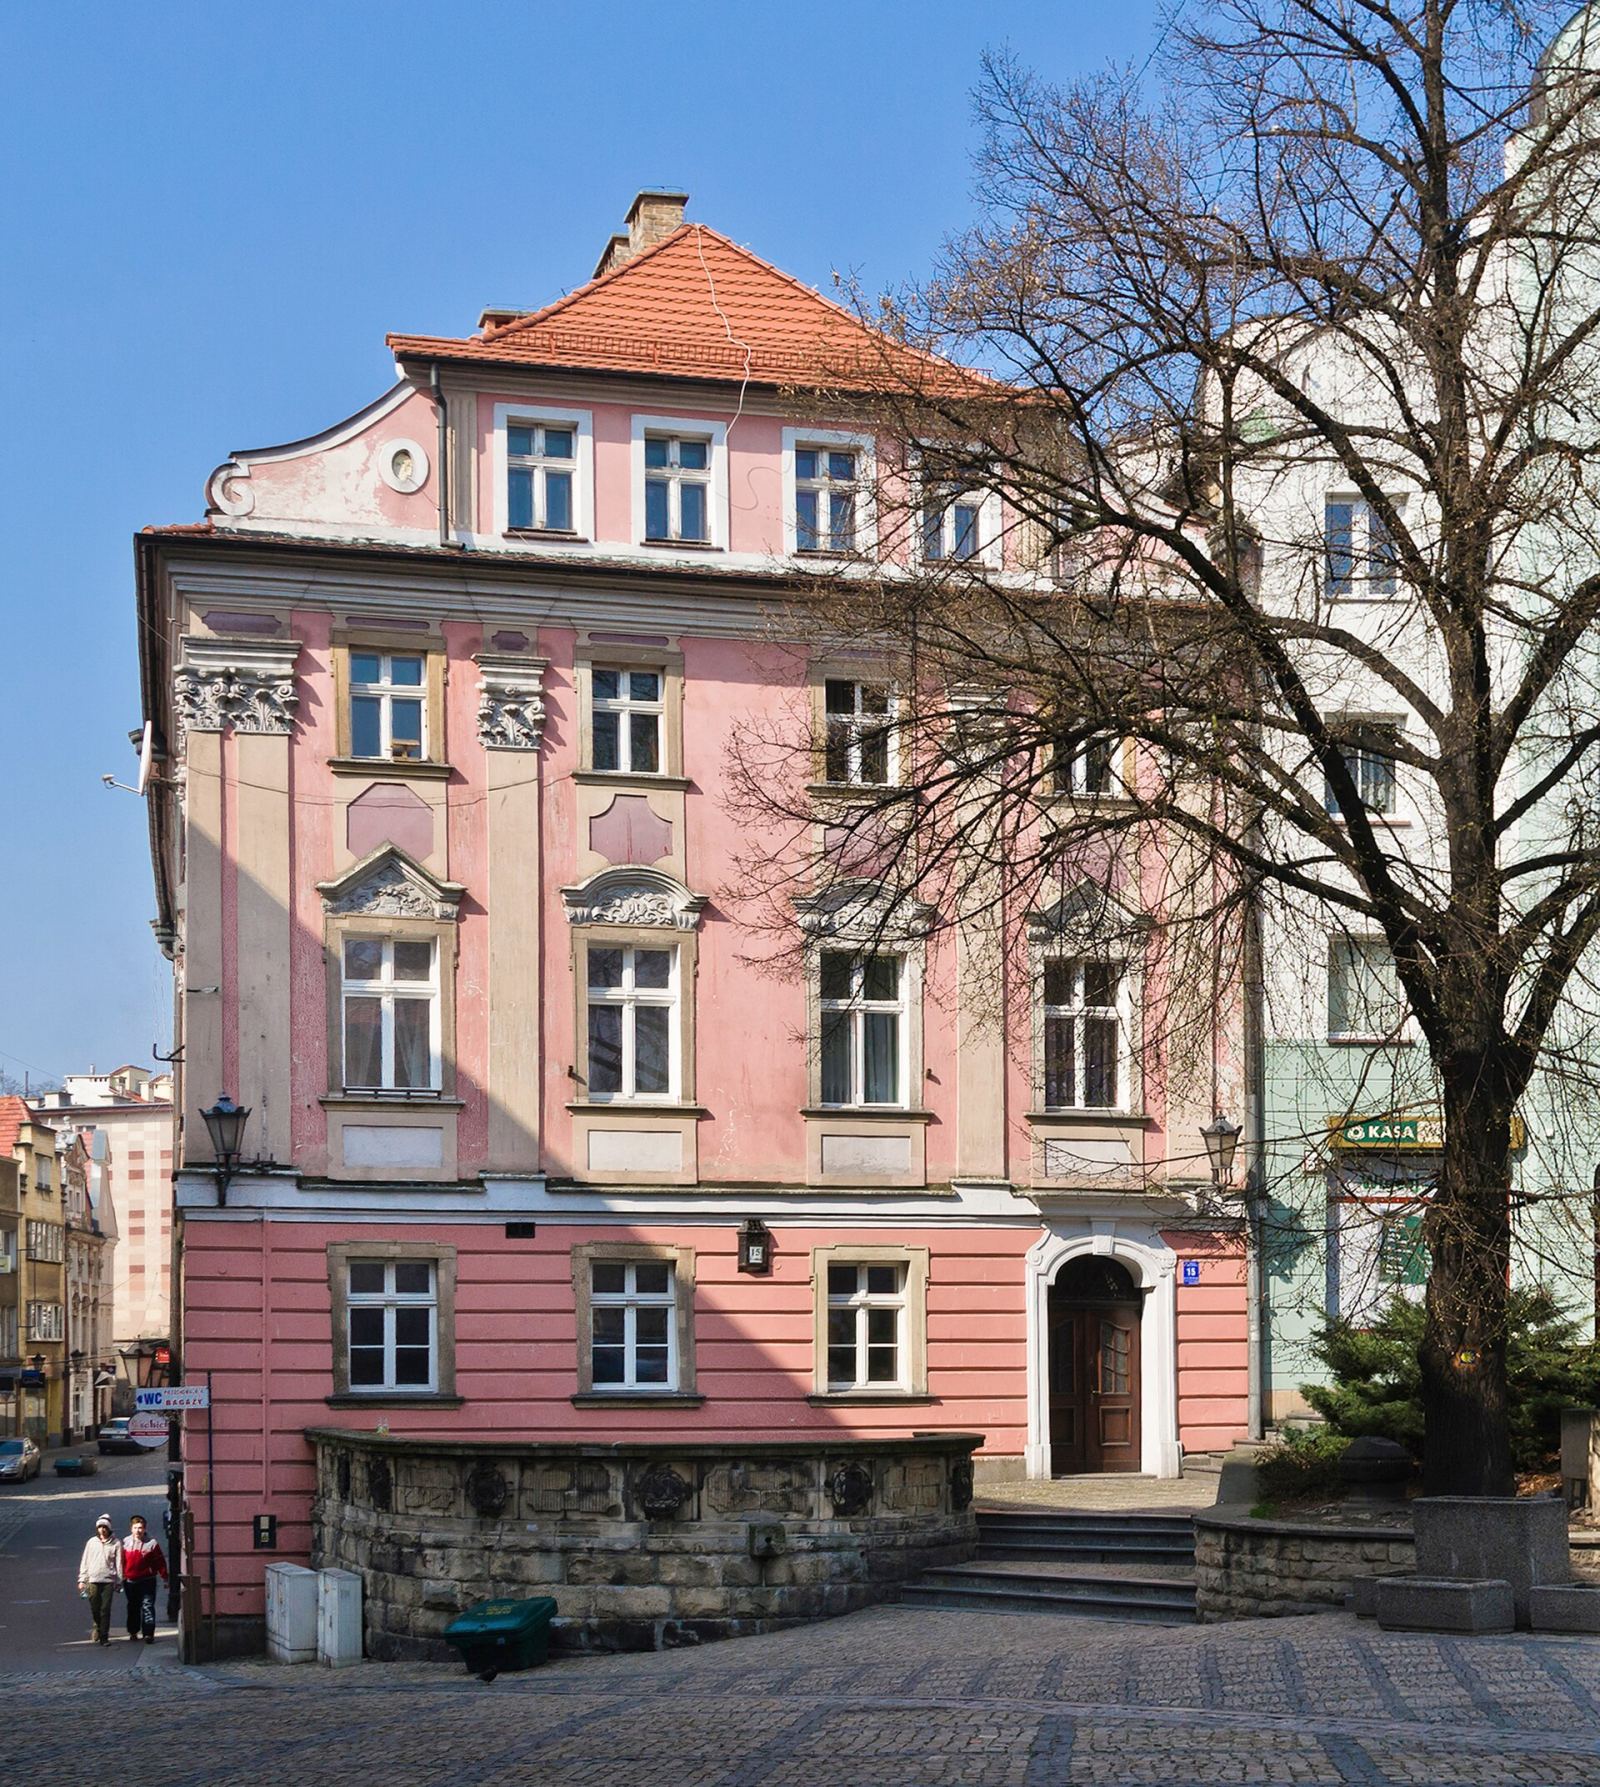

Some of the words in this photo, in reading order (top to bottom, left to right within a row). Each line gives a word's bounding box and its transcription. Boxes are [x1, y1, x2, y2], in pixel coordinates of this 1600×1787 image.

[1368, 1125, 1415, 1139] KASA
[1186, 1267, 1196, 1276] 15
[144, 1392, 162, 1405] WC
